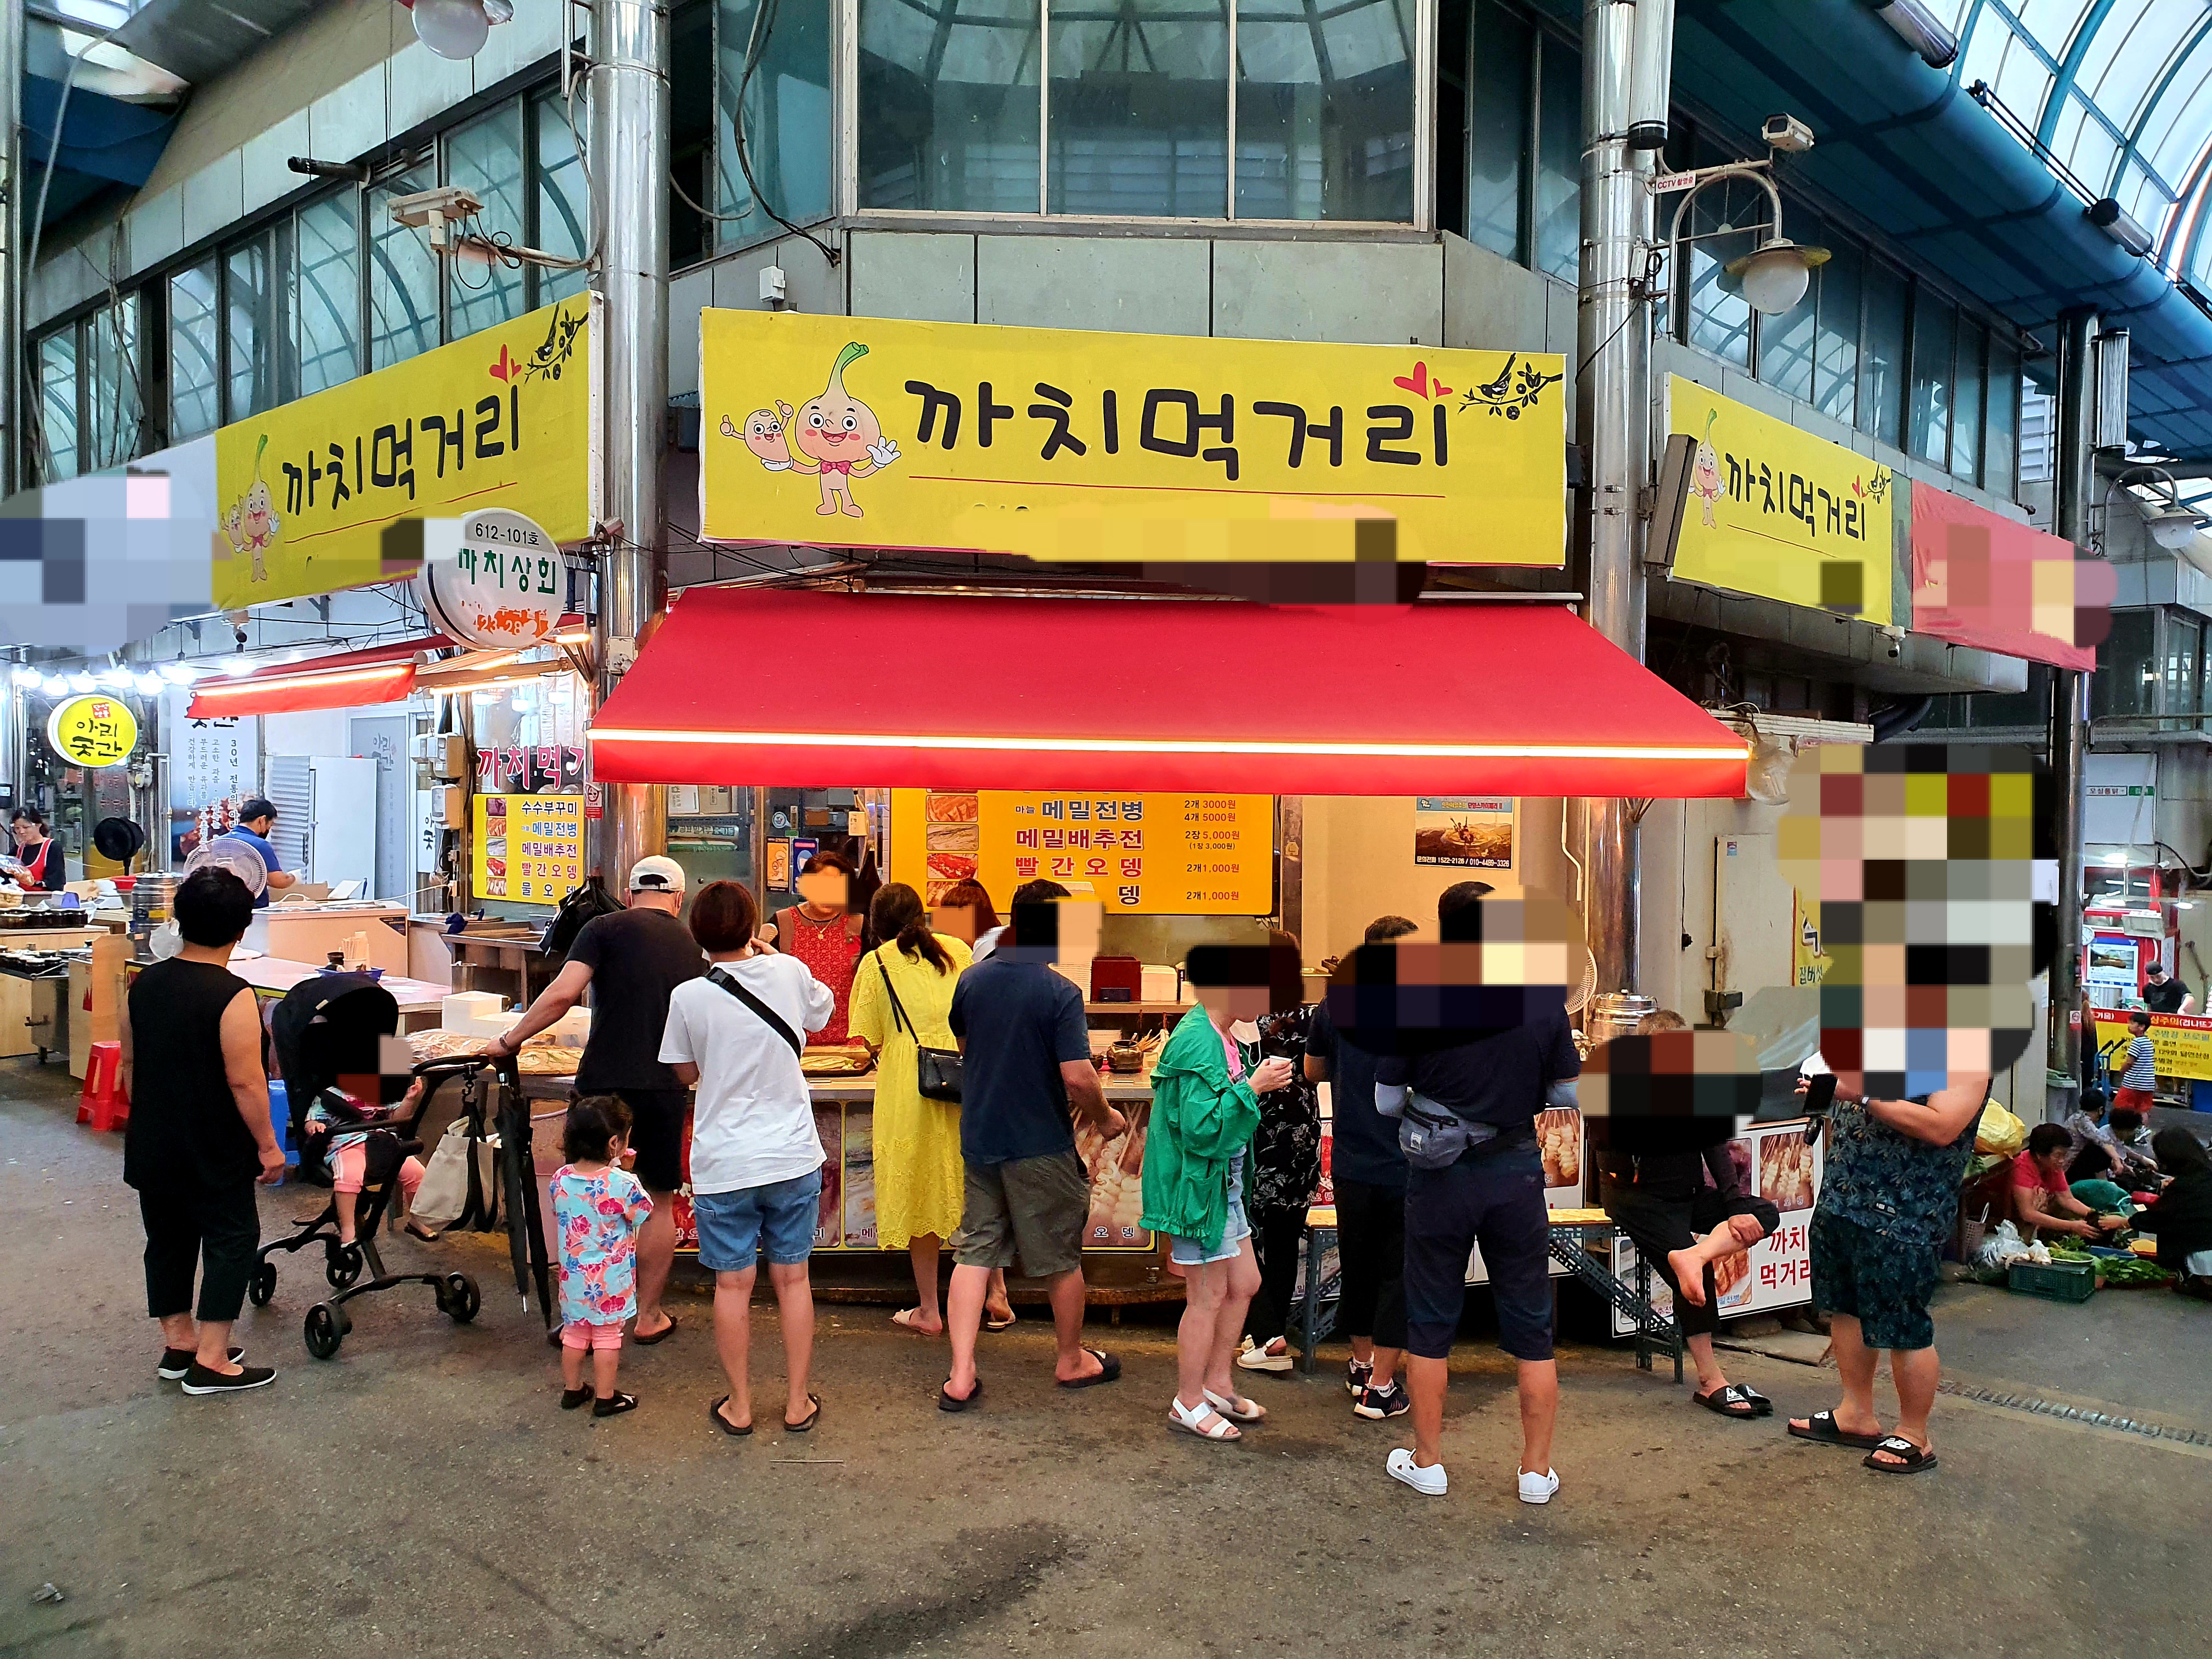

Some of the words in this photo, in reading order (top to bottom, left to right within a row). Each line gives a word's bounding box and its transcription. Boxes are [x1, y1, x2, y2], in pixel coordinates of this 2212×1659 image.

[1658, 179, 1676, 189] CCTV
[905, 380, 1448, 481] 까치먹거리
[282, 385, 519, 516] 까치먹거리
[1724, 452, 1865, 541] 까치먹거리
[475, 523, 539, 546] 612-101호
[458, 548, 556, 594] 까치상회
[76, 718, 117, 737] 아리
[200, 738, 208, 769] 부드러운
[230, 739, 239, 767] 30년
[229, 774, 239, 803] 전통의
[521, 801, 577, 816] 수수부꾸미
[1042, 800, 1143, 821] 메밀전병
[1184, 800, 1199, 809] 2개
[1203, 800, 1236, 809] 3000원
[1184, 812, 1199, 822] 4개
[1203, 812, 1236, 822] 5000원
[532, 822, 577, 837] 메밀전병
[1017, 828, 1142, 849] 메밀배추전
[1185, 831, 1200, 839] 2장
[1203, 831, 1239, 840] 5,000원
[521, 842, 577, 858] 메밀배추전
[1769, 1224, 1805, 1255] 까치
